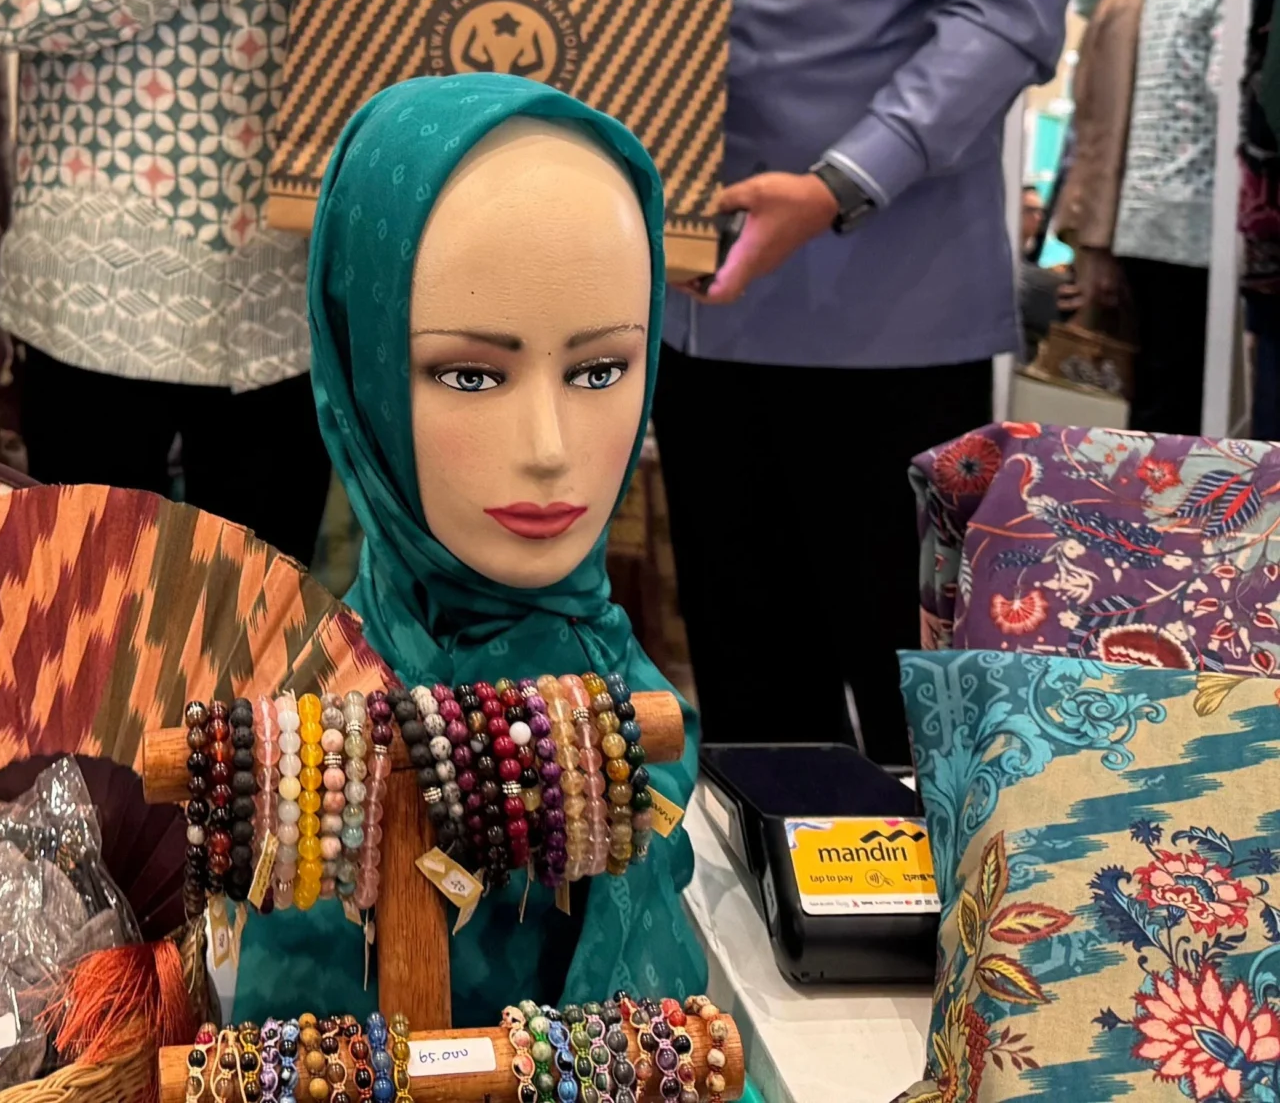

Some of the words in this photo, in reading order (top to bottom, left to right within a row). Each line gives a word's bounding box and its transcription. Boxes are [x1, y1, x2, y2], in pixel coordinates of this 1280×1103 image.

[430, 10, 453, 70] DEWAN
[818, 841, 909, 864] mandiri
[810, 873, 825, 883] tap
[826, 874, 836, 882] to
[837, 874, 854, 884] pay
[418, 1048, 469, 1064] 65.000
